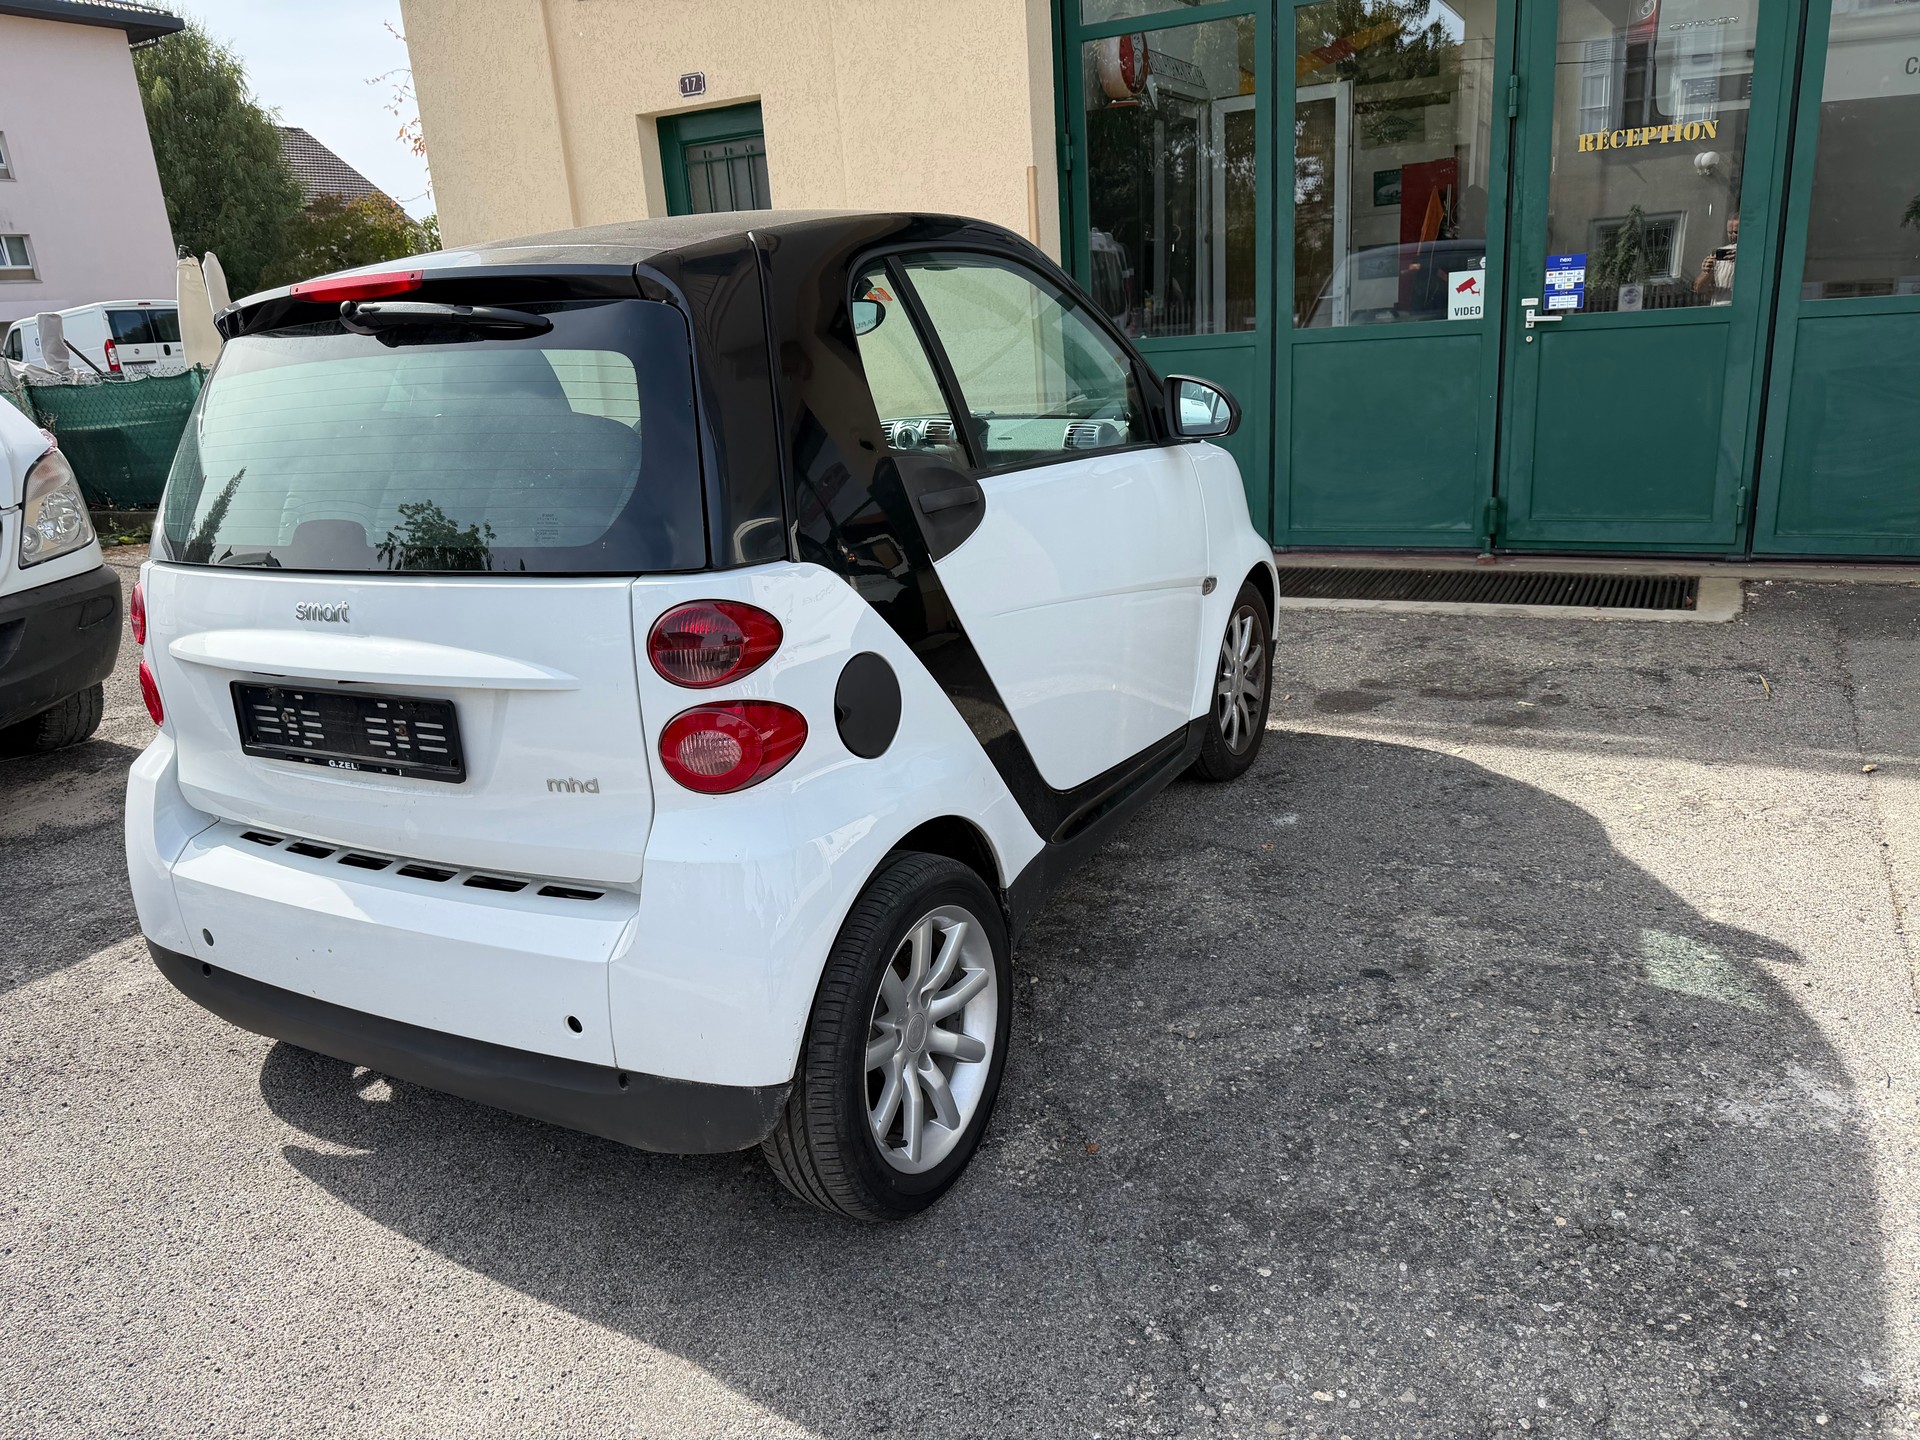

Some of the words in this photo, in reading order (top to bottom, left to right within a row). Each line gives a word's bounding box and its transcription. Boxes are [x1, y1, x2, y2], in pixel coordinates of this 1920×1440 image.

[685, 77, 696, 92] 17
[1578, 120, 1719, 152] RÉCEPTION
[1454, 305, 1481, 317] VIDEO
[295, 600, 351, 624] smart
[546, 776, 600, 794] mhd
